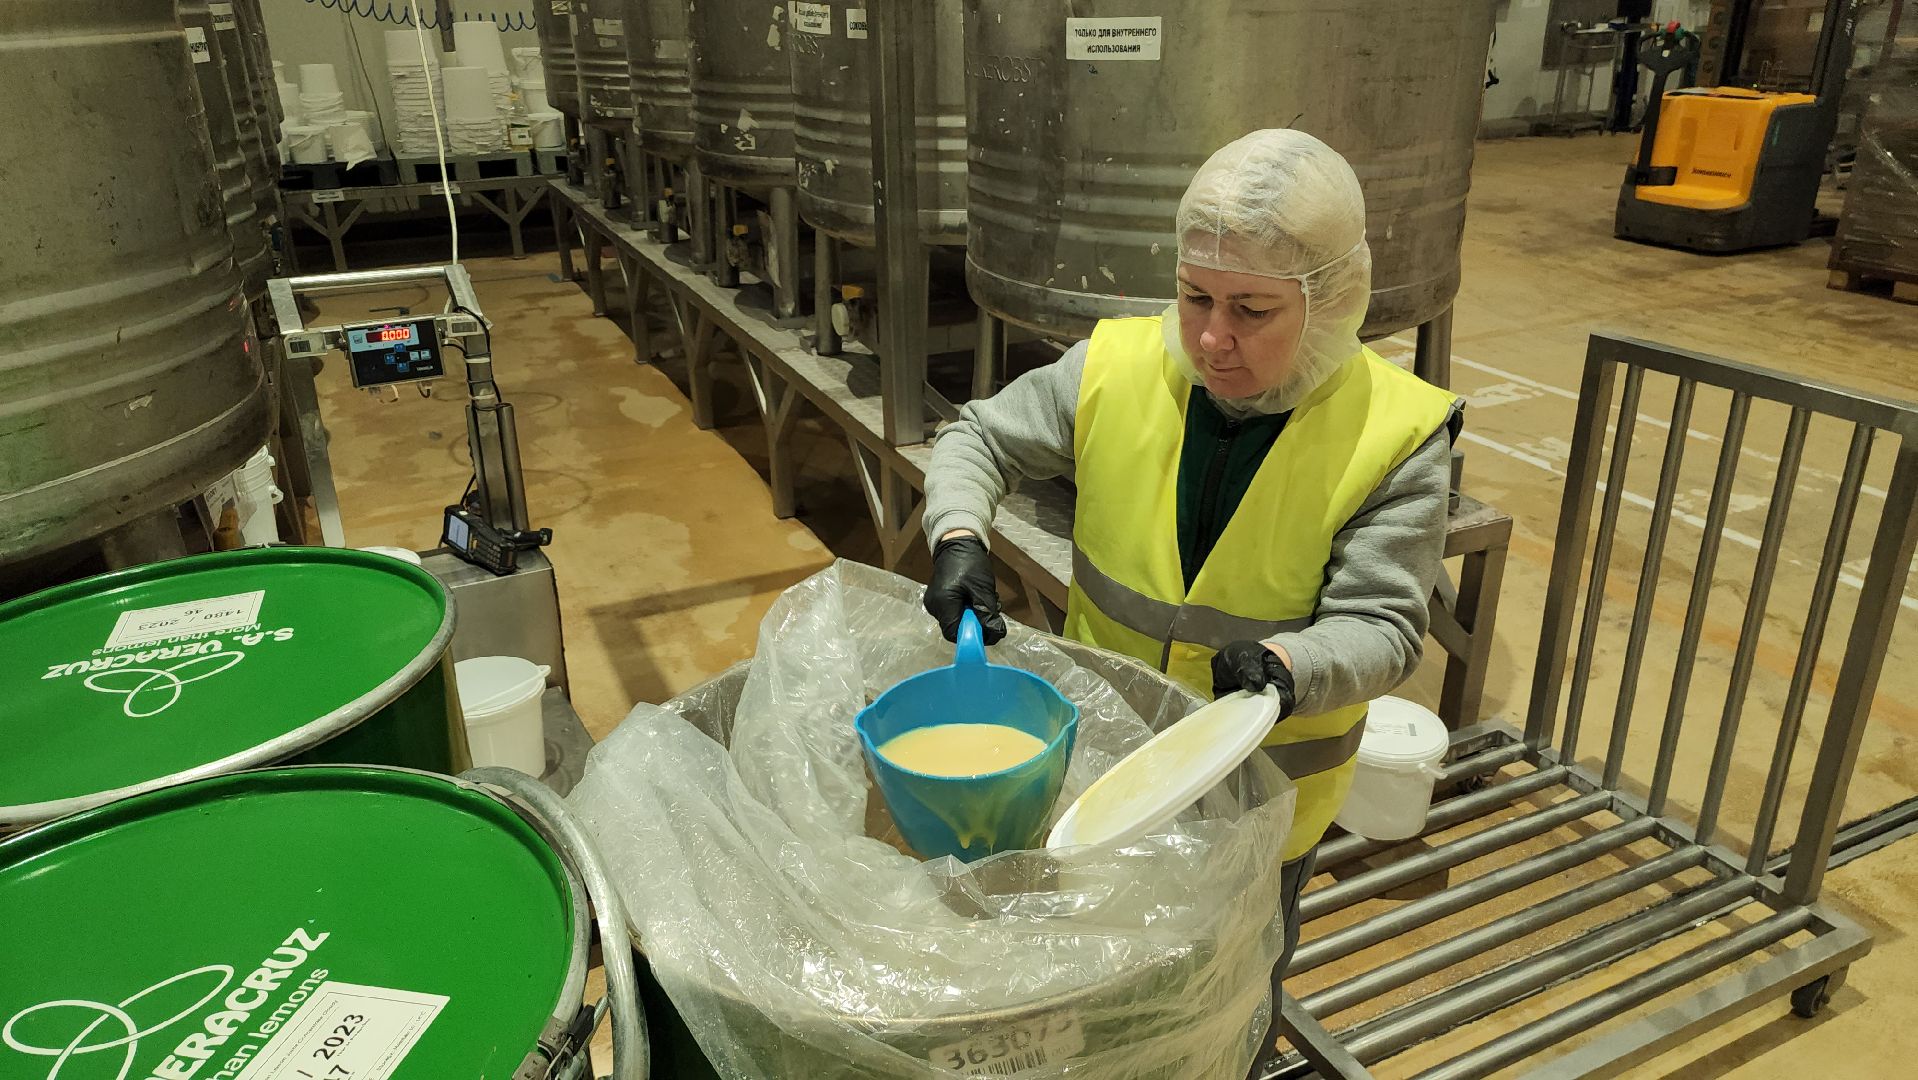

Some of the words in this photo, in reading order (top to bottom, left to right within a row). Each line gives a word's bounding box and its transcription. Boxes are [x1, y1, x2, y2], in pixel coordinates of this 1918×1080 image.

[1074, 28, 1097, 38] ТОЛЬКО
[1098, 28, 1111, 39] ДЛЯ
[1111, 27, 1157, 38] ВНУТРЕННЕГО
[1087, 44, 1141, 54] ИСПОЛЬЗОВАНИЯ
[137, 619, 180, 630] 2023
[214, 623, 262, 635] More
[168, 632, 209, 643] than
[232, 627, 294, 646] S.A.
[92, 639, 162, 655] lemons
[40, 640, 223, 680] VERACRUZ
[144, 928, 331, 1080] ERACRUZ
[205, 1044, 259, 1080] han
[248, 968, 329, 1039] lemons
[312, 1014, 364, 1061] 2023
[323, 1064, 350, 1080] 7
